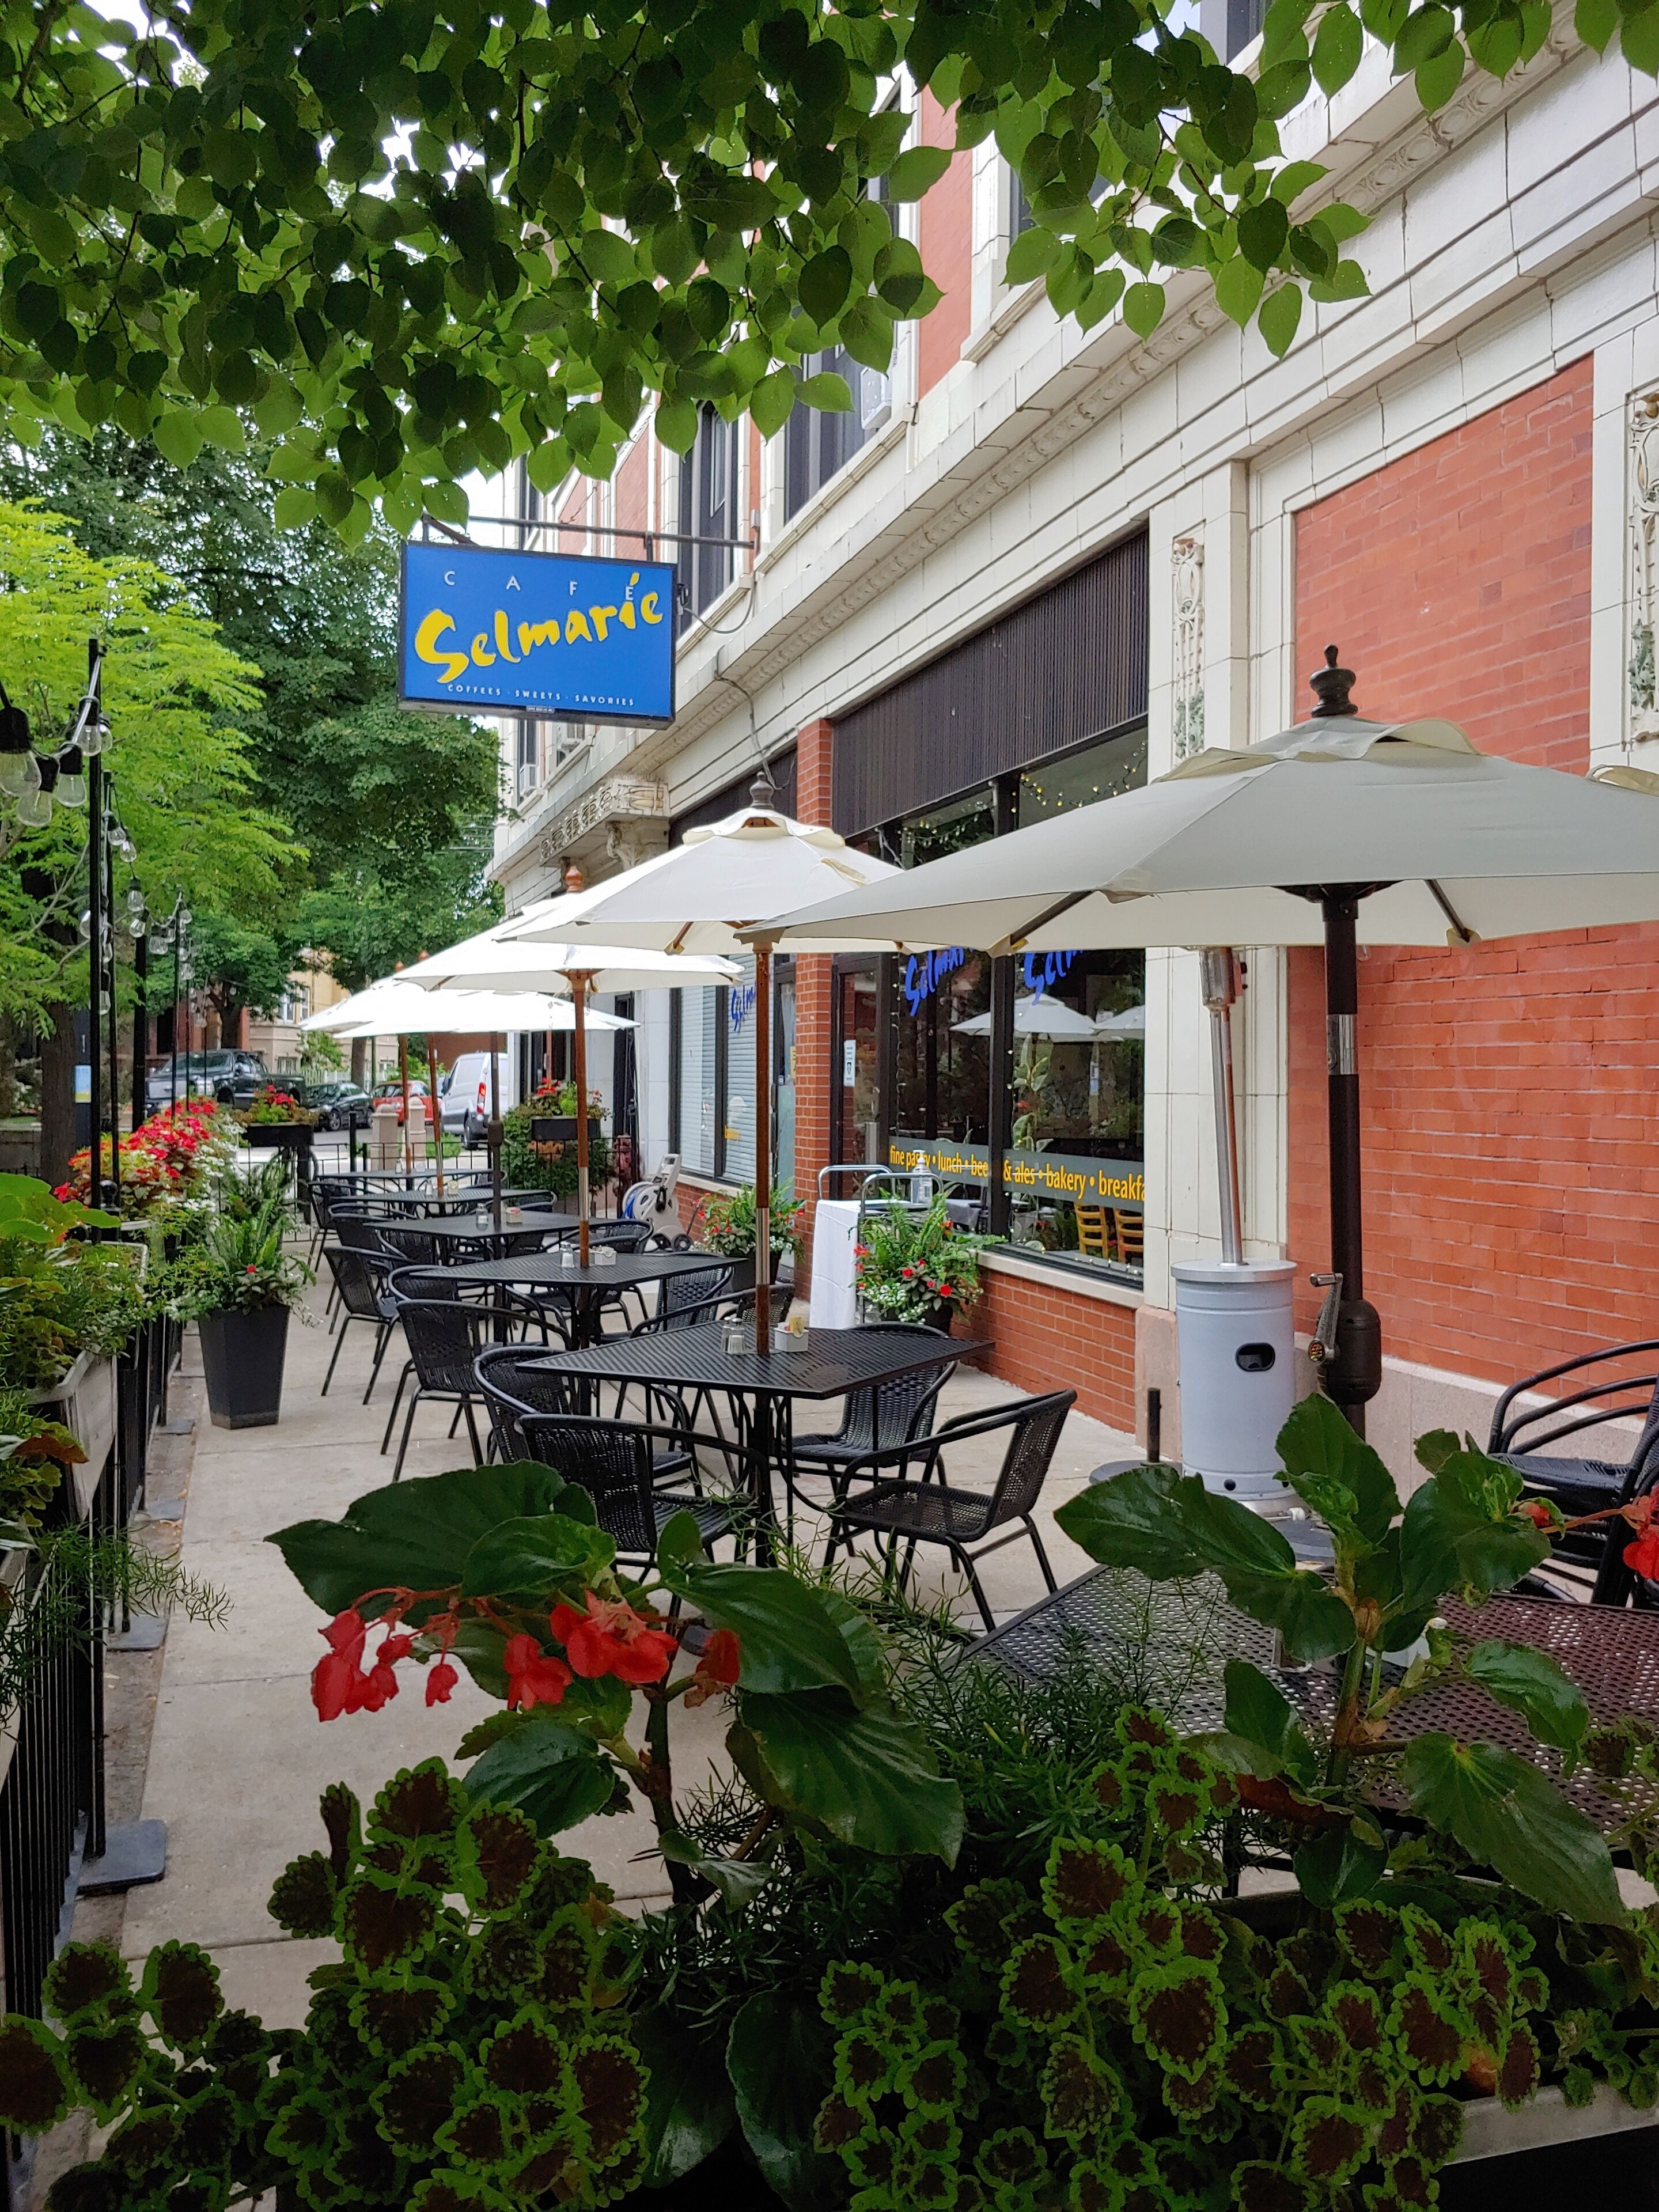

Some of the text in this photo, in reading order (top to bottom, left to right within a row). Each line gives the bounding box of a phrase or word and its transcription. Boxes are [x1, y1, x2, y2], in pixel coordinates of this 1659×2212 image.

[447, 684, 634, 706] COFFEES SWEETS SAVORIES
[889, 1145, 905, 1165] fine
[938, 1150, 963, 1174] lunch
[1003, 1160, 1145, 1202] & ales bakery breakfa
